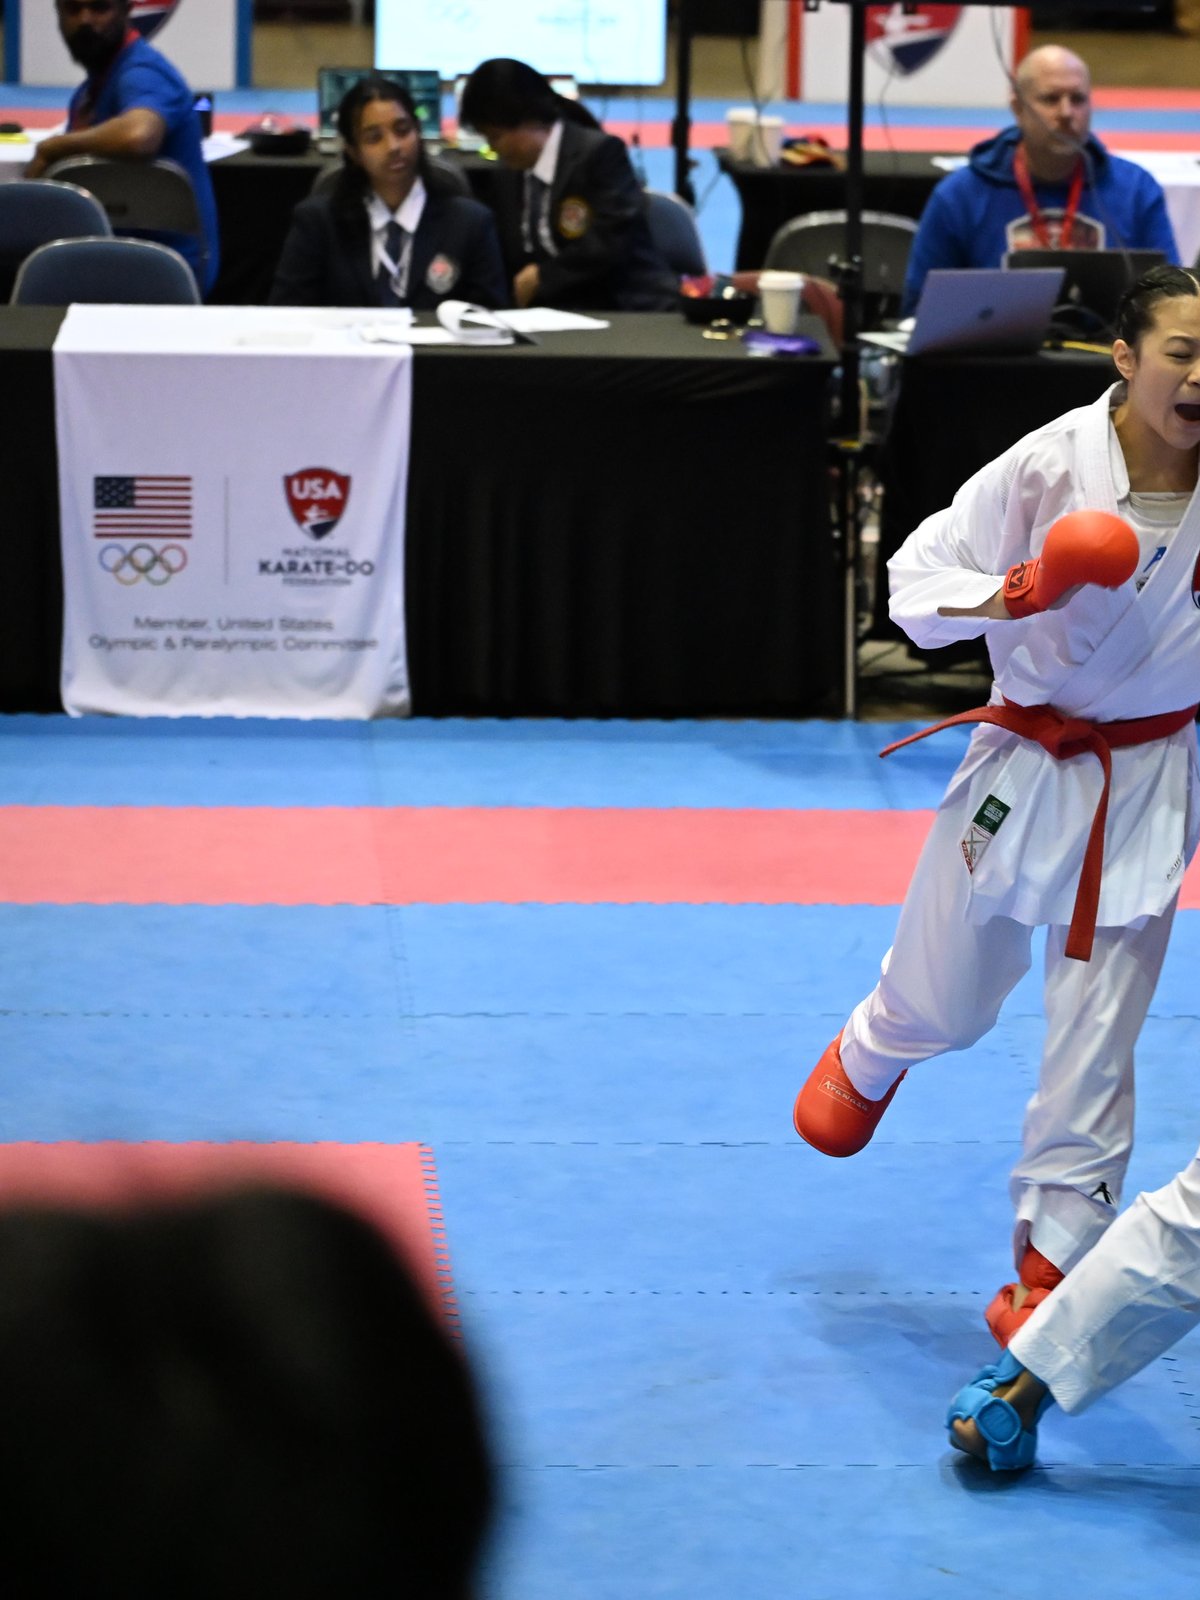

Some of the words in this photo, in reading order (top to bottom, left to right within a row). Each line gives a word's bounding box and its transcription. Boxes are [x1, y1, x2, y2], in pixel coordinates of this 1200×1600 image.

[292, 479, 342, 500] USA
[259, 560, 375, 577] KARATE-DO
[218, 616, 274, 631] United
[279, 616, 334, 631] States
[88, 634, 156, 652] Olympic
[182, 637, 277, 652] Paralympic
